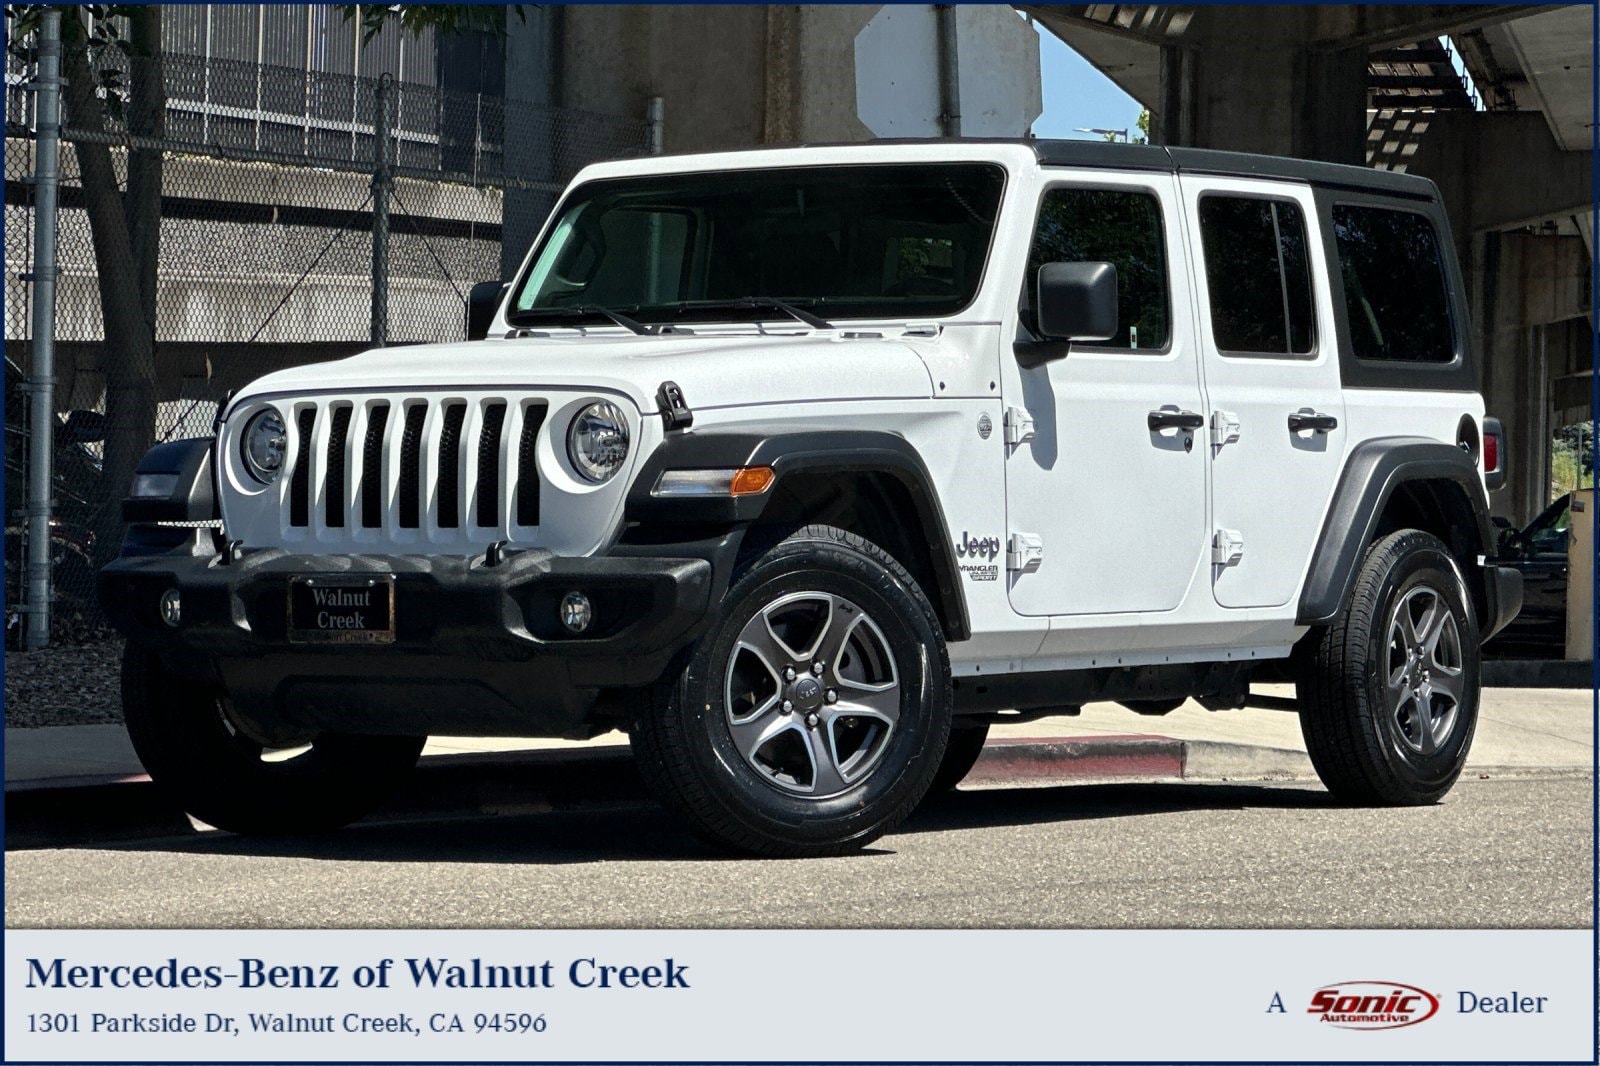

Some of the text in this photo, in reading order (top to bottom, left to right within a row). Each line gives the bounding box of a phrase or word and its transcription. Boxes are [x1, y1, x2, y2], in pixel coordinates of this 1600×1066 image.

[956, 531, 1000, 562] Jeep
[312, 588, 371, 606] Walnut
[317, 611, 366, 629] Creek
